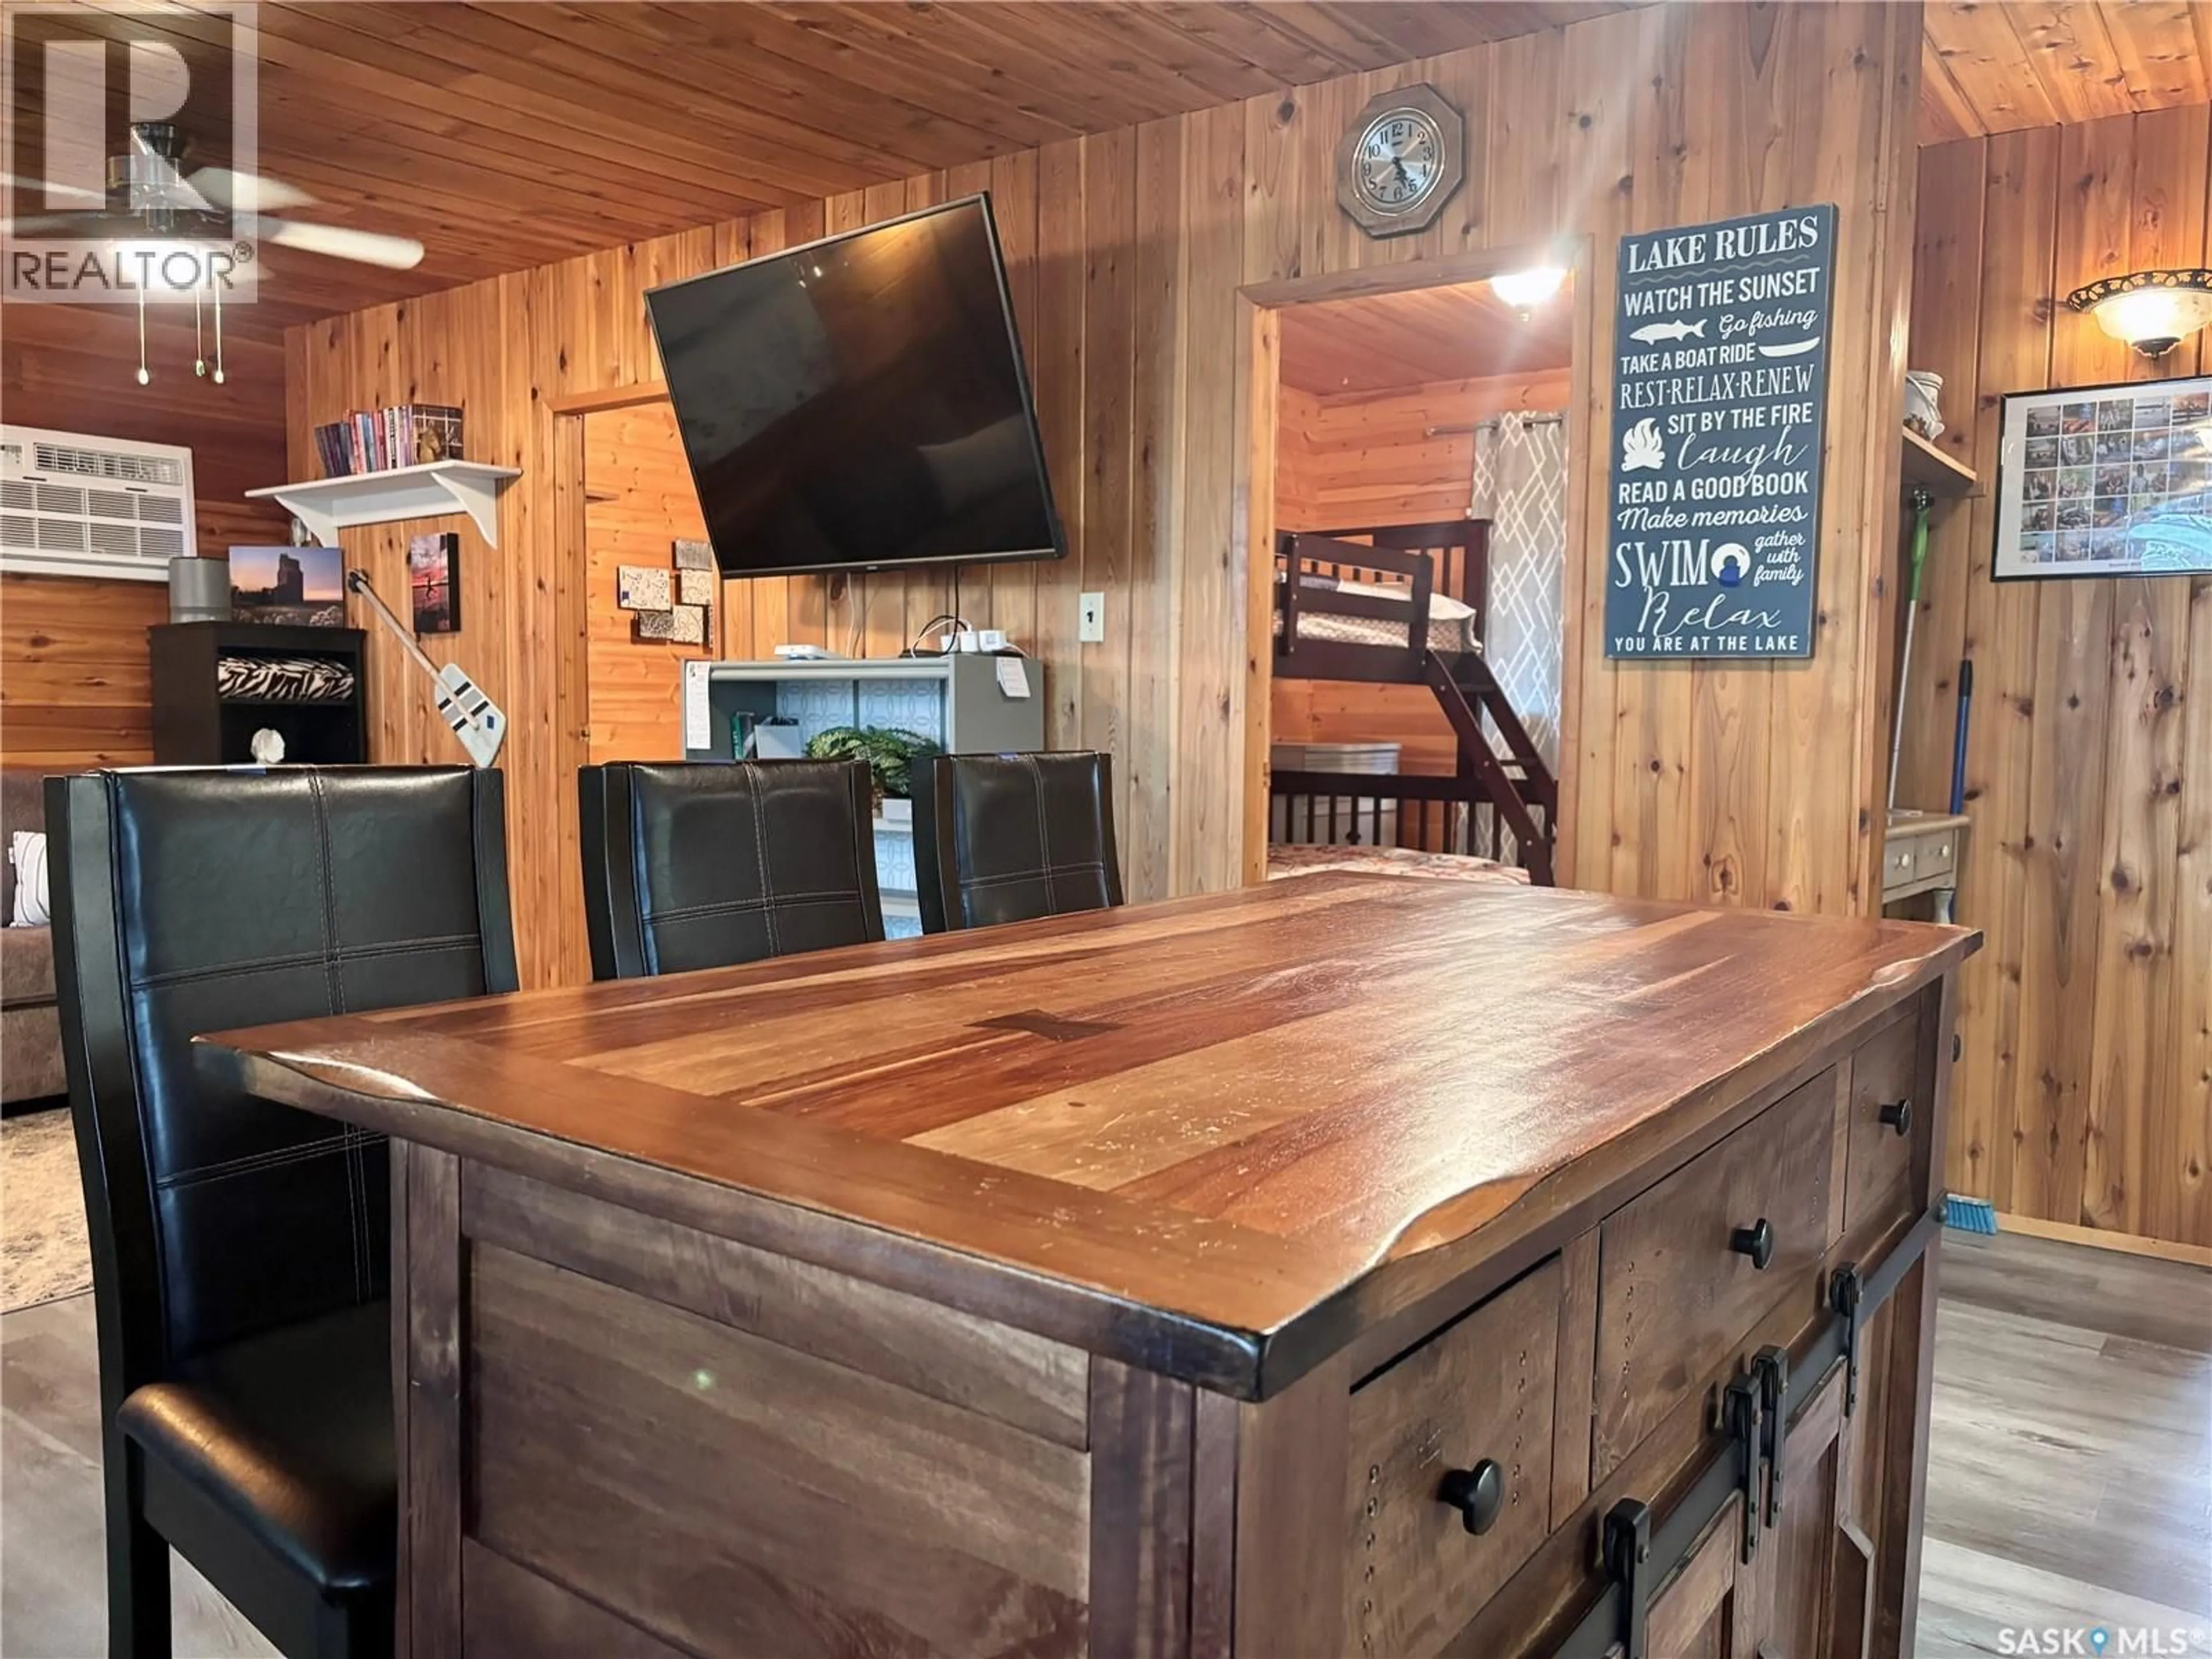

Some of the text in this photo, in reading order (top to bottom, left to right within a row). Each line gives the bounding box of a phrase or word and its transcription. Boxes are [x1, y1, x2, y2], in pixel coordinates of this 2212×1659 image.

[1380, 130, 1388, 144] 11
[1392, 122, 1403, 137] 12
[1369, 144, 1380, 159] 10
[1627, 216, 1819, 273] LAKE RULES
[1625, 268, 1820, 317] WATCH THE SUNSET
[1719, 309, 1819, 339] Go fishing
[1620, 343, 1756, 374] TAKE A BOAT RIDE
[1668, 402, 1813, 434] SIT BY THE FIRE
[1619, 471, 1808, 504] READ A GOOD BOOK
[1617, 505, 1808, 531] Make memories
[1754, 531, 1805, 554] gather
[1767, 548, 1801, 563] with
[1615, 539, 1710, 588] SWIM
[1754, 565, 1804, 586] family
[1638, 585, 1781, 638] Relax
[1615, 636, 1798, 652] YOU ARE AT THE LAKE
